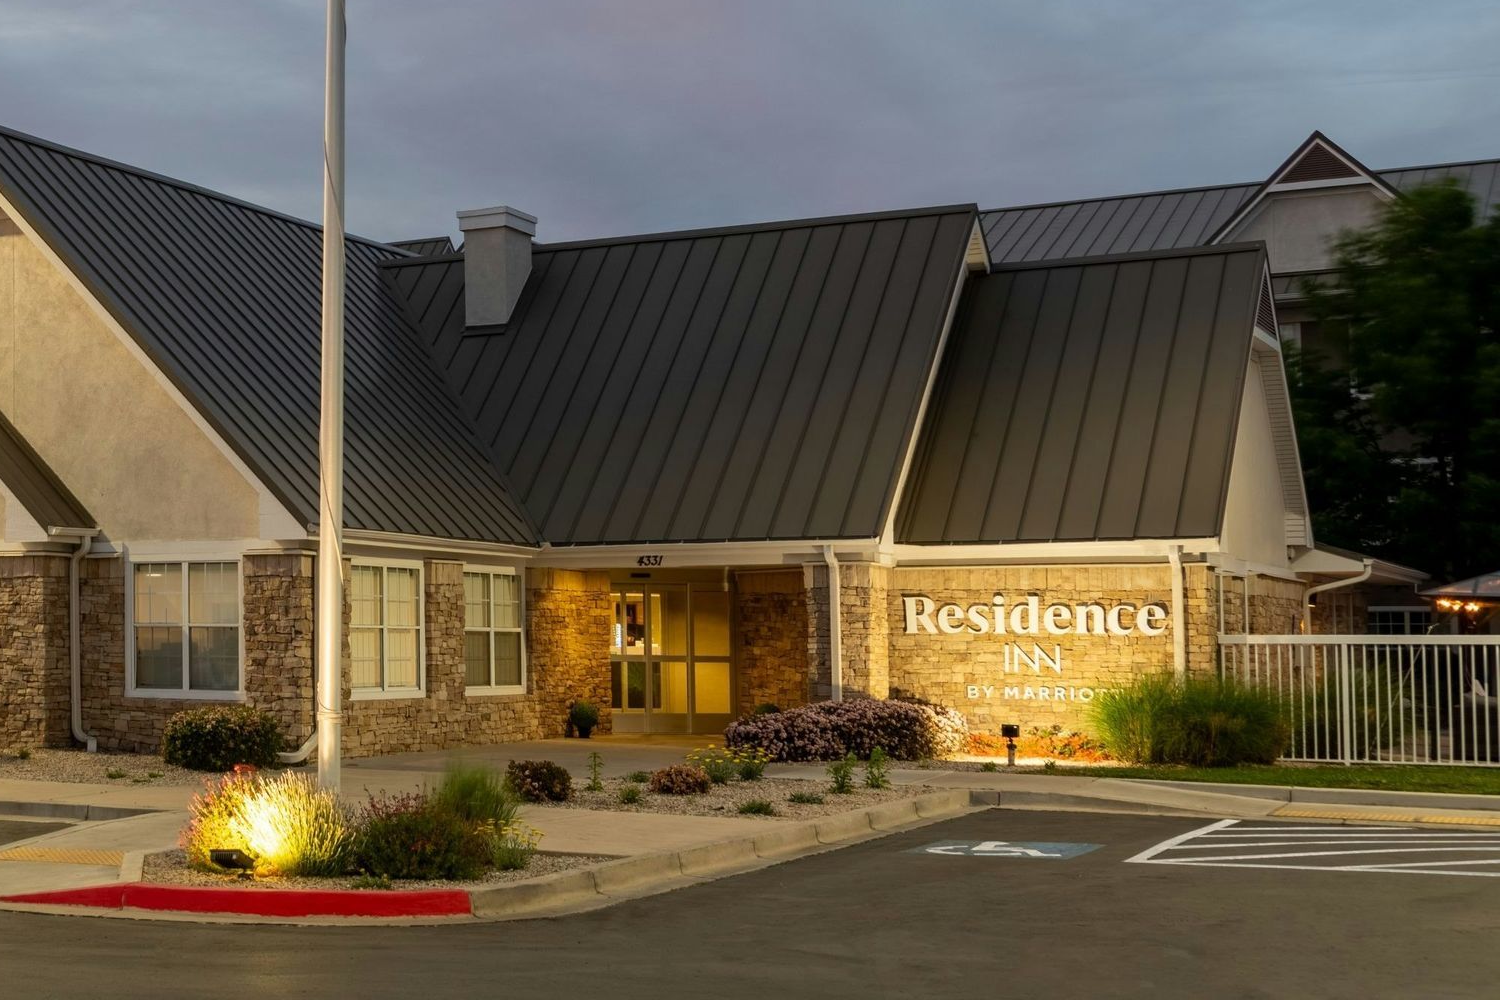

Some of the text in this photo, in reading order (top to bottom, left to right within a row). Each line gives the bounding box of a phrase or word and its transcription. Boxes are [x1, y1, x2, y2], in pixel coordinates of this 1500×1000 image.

[636, 554, 663, 567] 4331
[901, 593, 1169, 636] Residence
[1004, 641, 1063, 674] INN
[966, 685, 994, 699] BY
